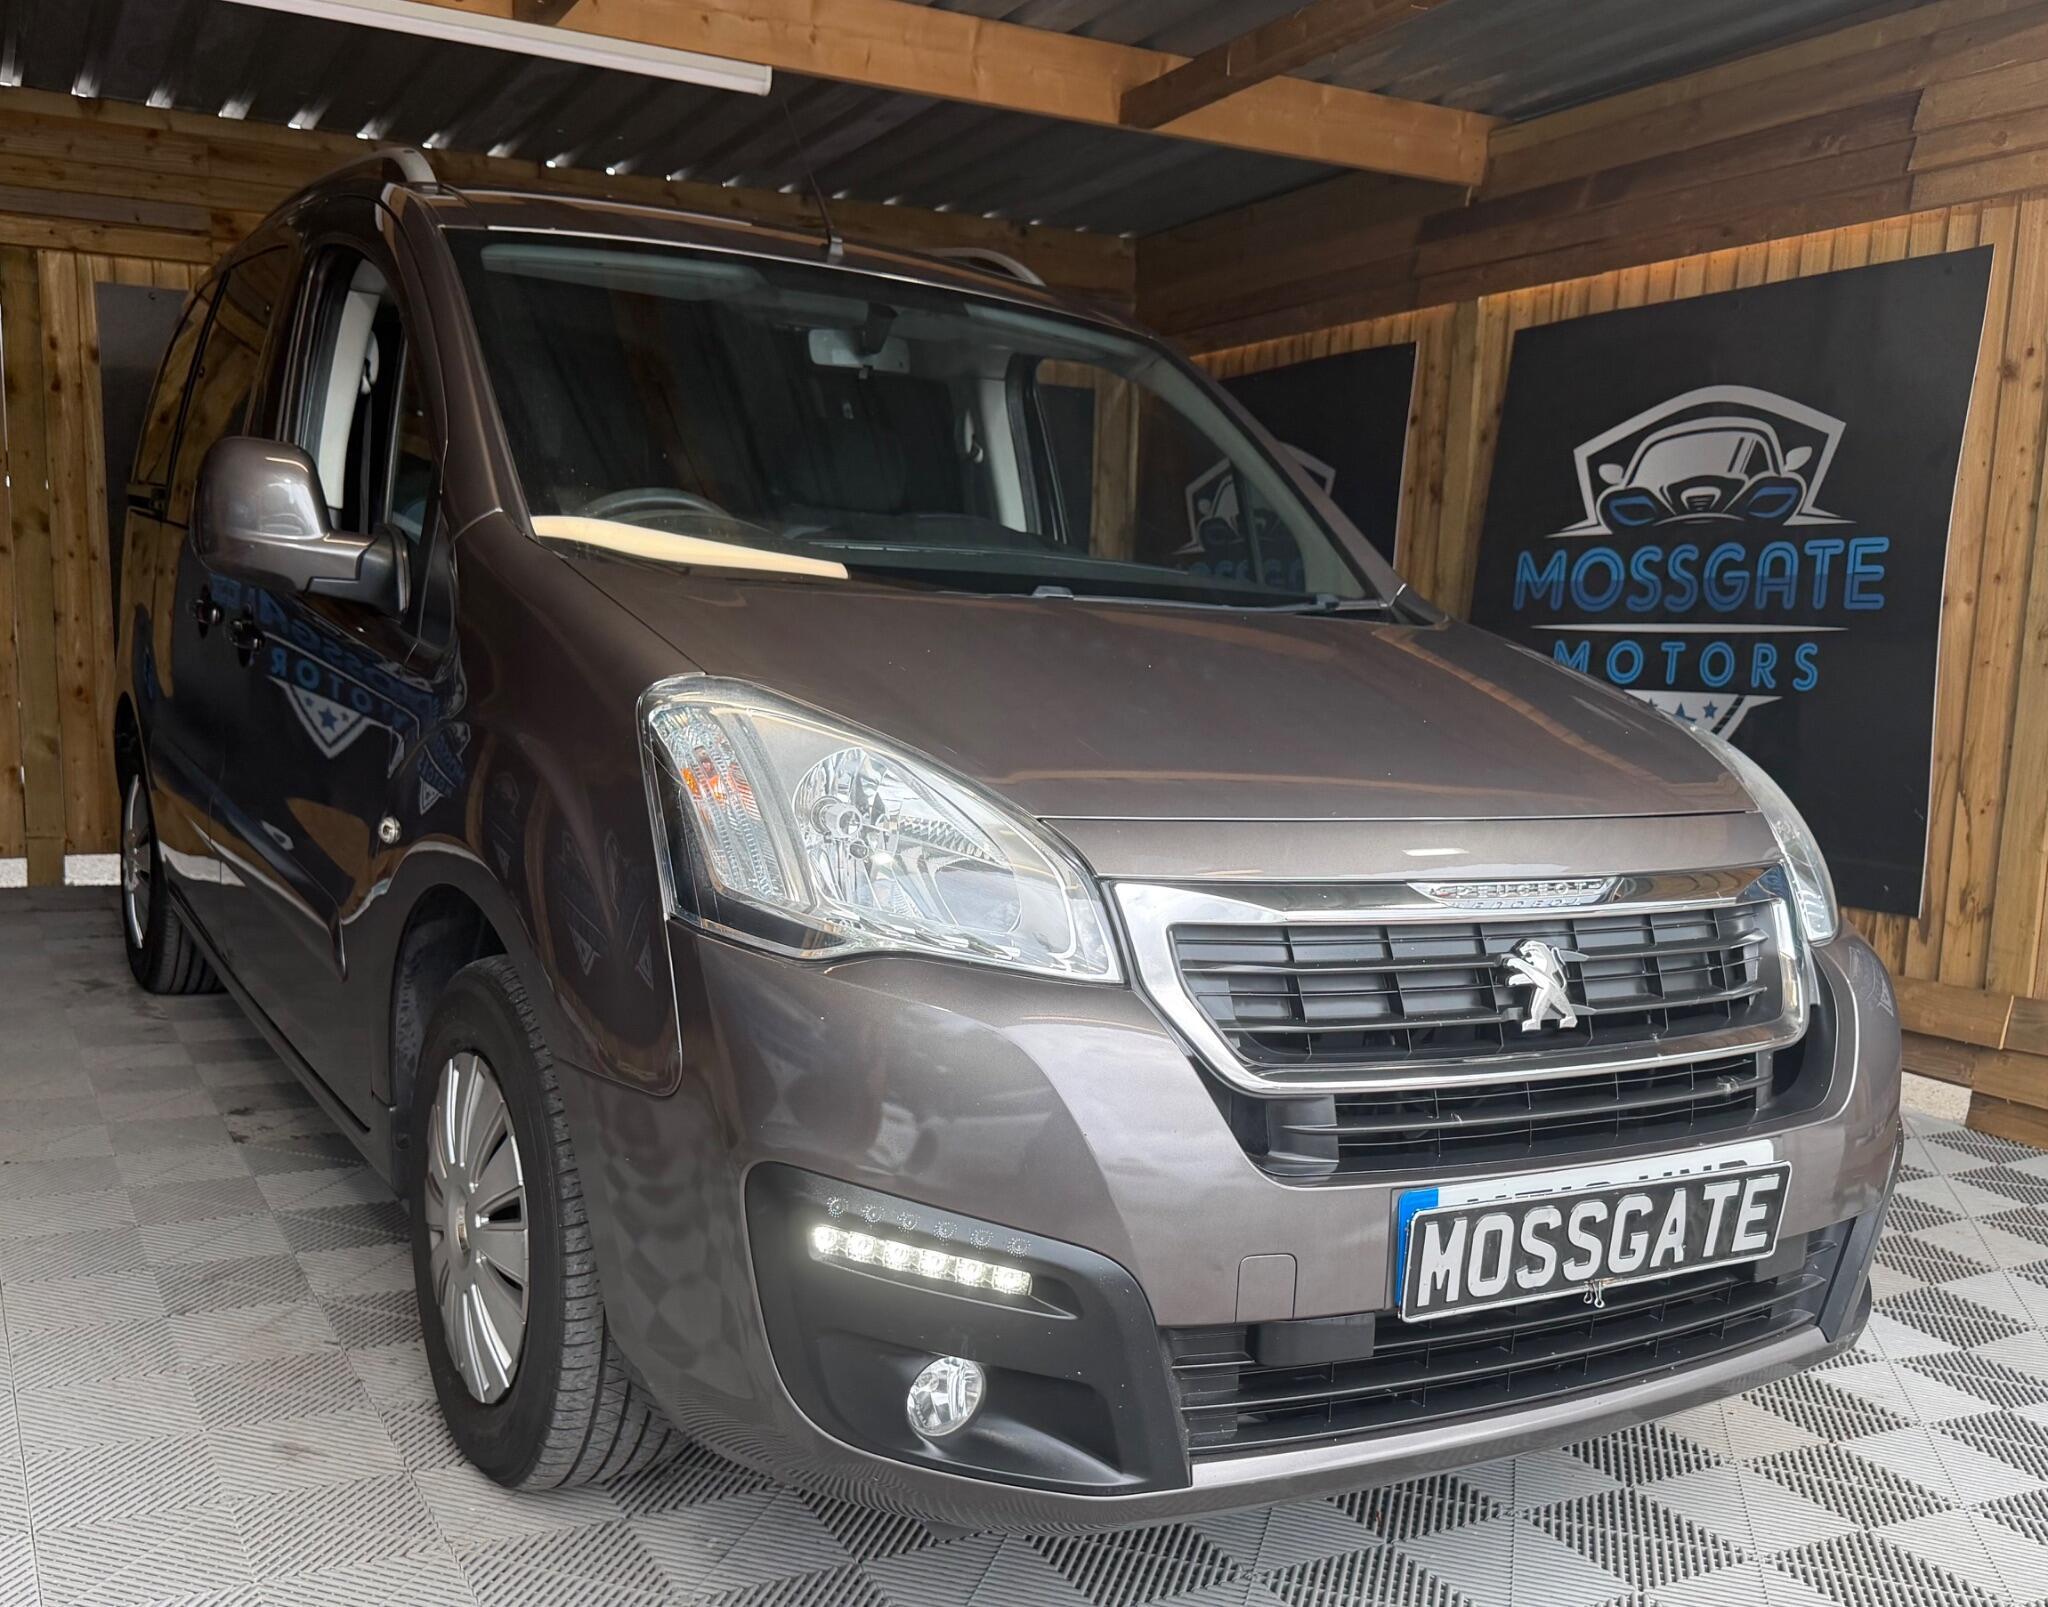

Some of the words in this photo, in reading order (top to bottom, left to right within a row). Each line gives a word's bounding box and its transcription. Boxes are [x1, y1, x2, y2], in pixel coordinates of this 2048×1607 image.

[1513, 537, 1890, 612] MOSSGATE
[1553, 639, 1819, 692] MOTORS
[1416, 1173, 1781, 1308] MOSSGATE
